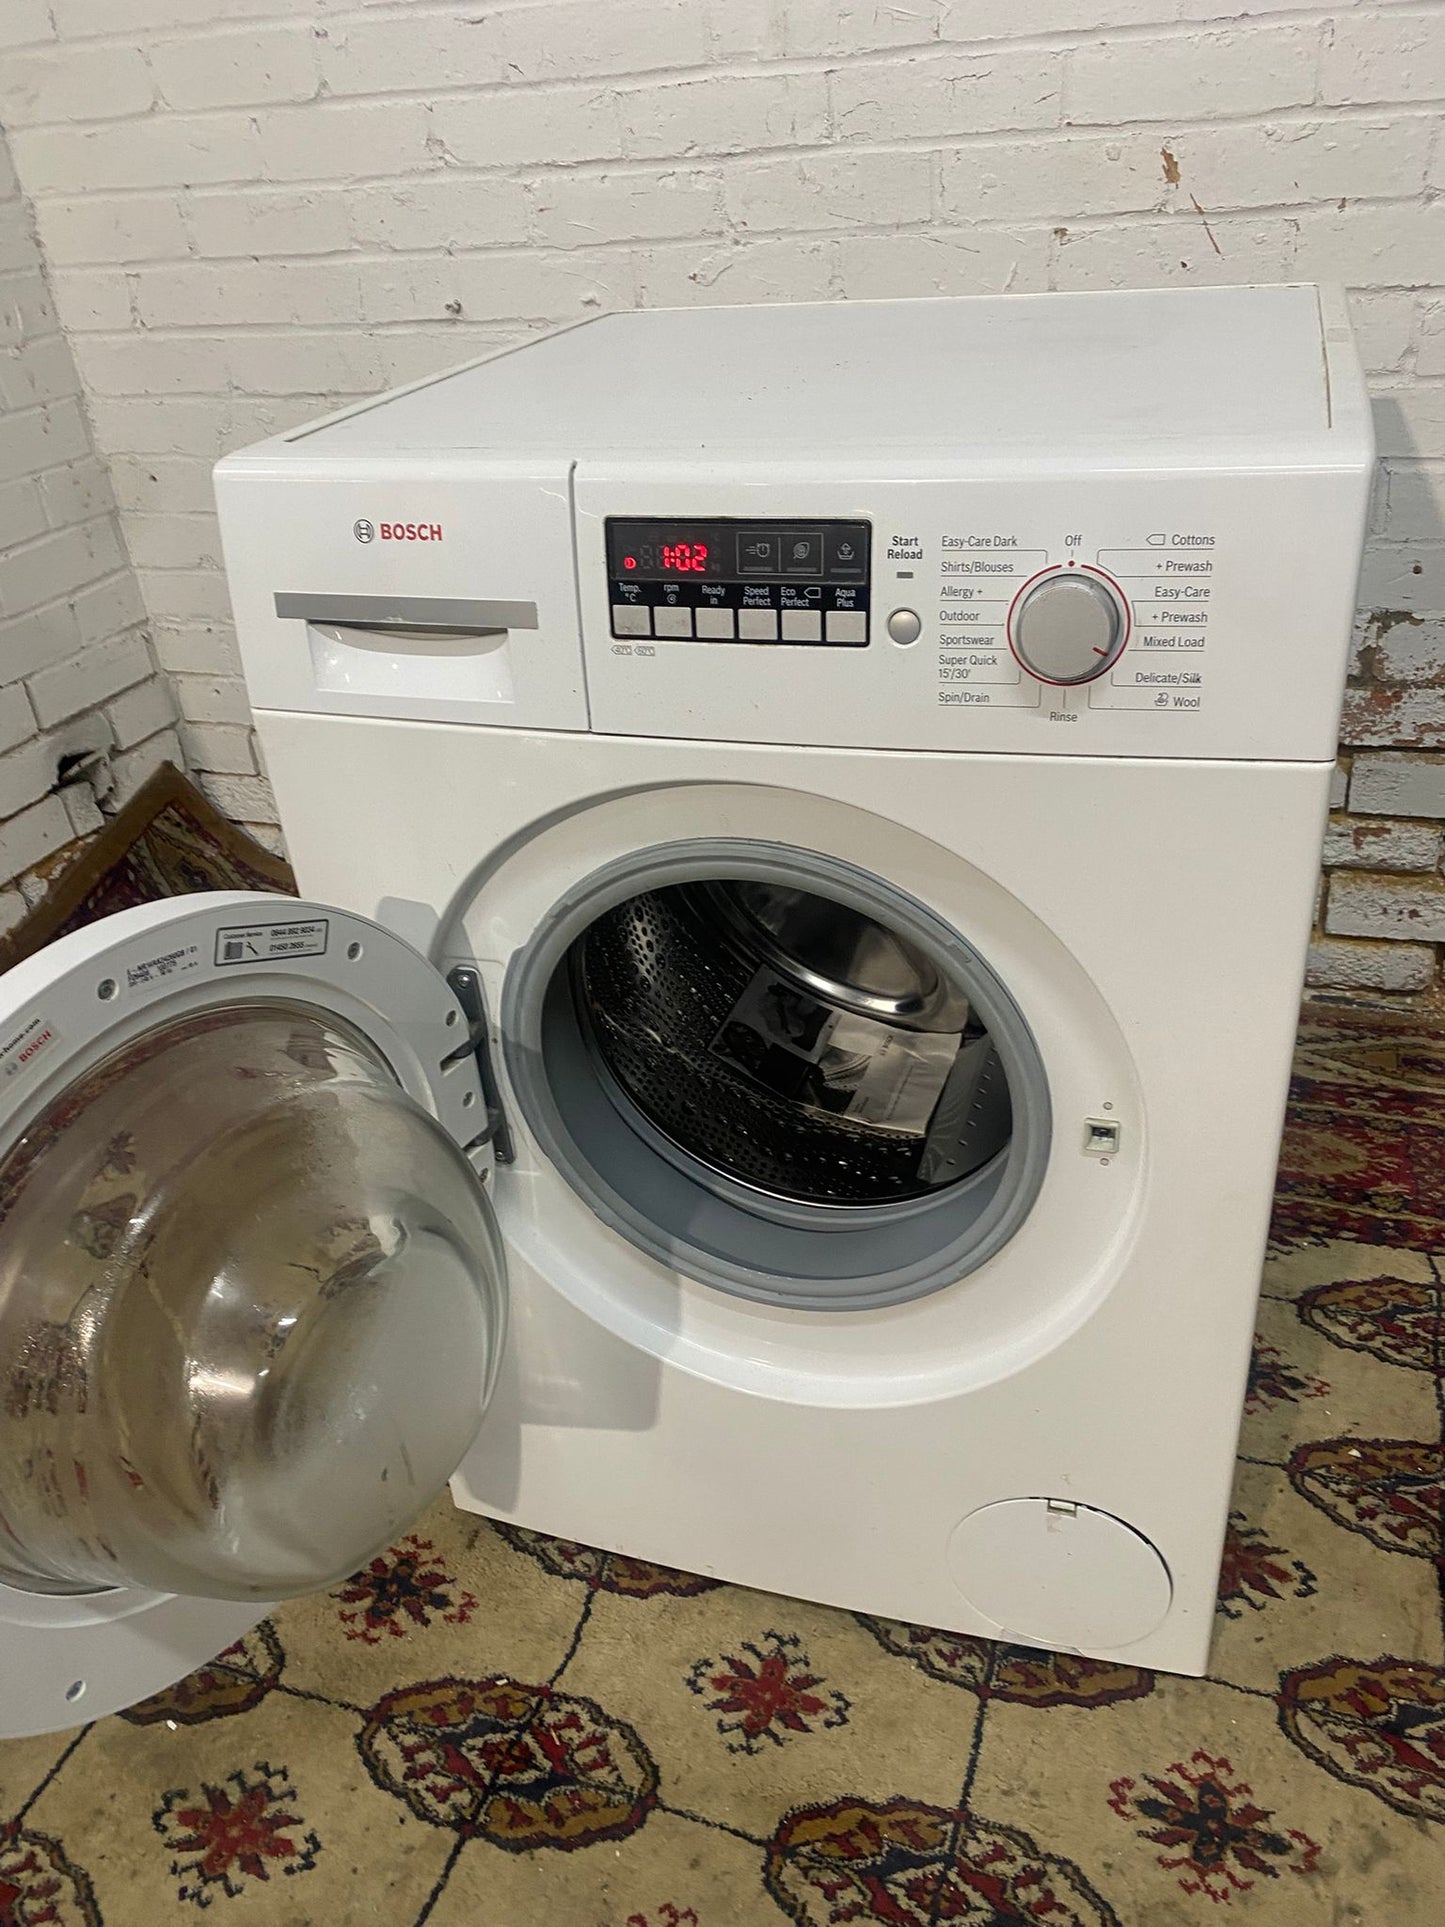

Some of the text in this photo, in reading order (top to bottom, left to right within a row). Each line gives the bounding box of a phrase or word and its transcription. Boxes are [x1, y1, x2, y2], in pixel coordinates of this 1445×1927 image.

[380, 523, 442, 541] BOSCH
[892, 535, 919, 547] Start
[941, 535, 1018, 548] Easy-Care Dark
[1064, 534, 1082, 546] Off
[1171, 534, 1216, 546] Cottons
[663, 543, 708, 571] 1:02
[887, 549, 923, 560] Reload
[941, 561, 1014, 574] Shirts/Blouses
[1165, 560, 1213, 571] Prewash
[618, 582, 642, 593] Temp.
[663, 584, 680, 593] rpm
[701, 585, 726, 596] Ready
[744, 585, 770, 597] Speed
[780, 587, 797, 596] Eco
[834, 588, 857, 598] Aqua
[940, 586, 974, 599] Allergy
[1154, 586, 1211, 599] Easy-Care
[709, 596, 719, 604] in
[742, 597, 772, 606] Perfect
[780, 597, 810, 607] Perfect
[836, 598, 854, 607] Plus
[939, 610, 980, 621] Outdoor
[1161, 611, 1208, 623] Prewash
[939, 634, 995, 646] Sportswear
[1143, 636, 1205, 648] Mixed Load
[938, 654, 998, 667] Super Quick
[1135, 672, 1202, 685] Delicate/Silk
[938, 691, 990, 704] Spin/Drain
[1173, 696, 1201, 708] Wool
[1049, 711, 1079, 723] Rinse
[18, 1029, 53, 1062] BOSCH
